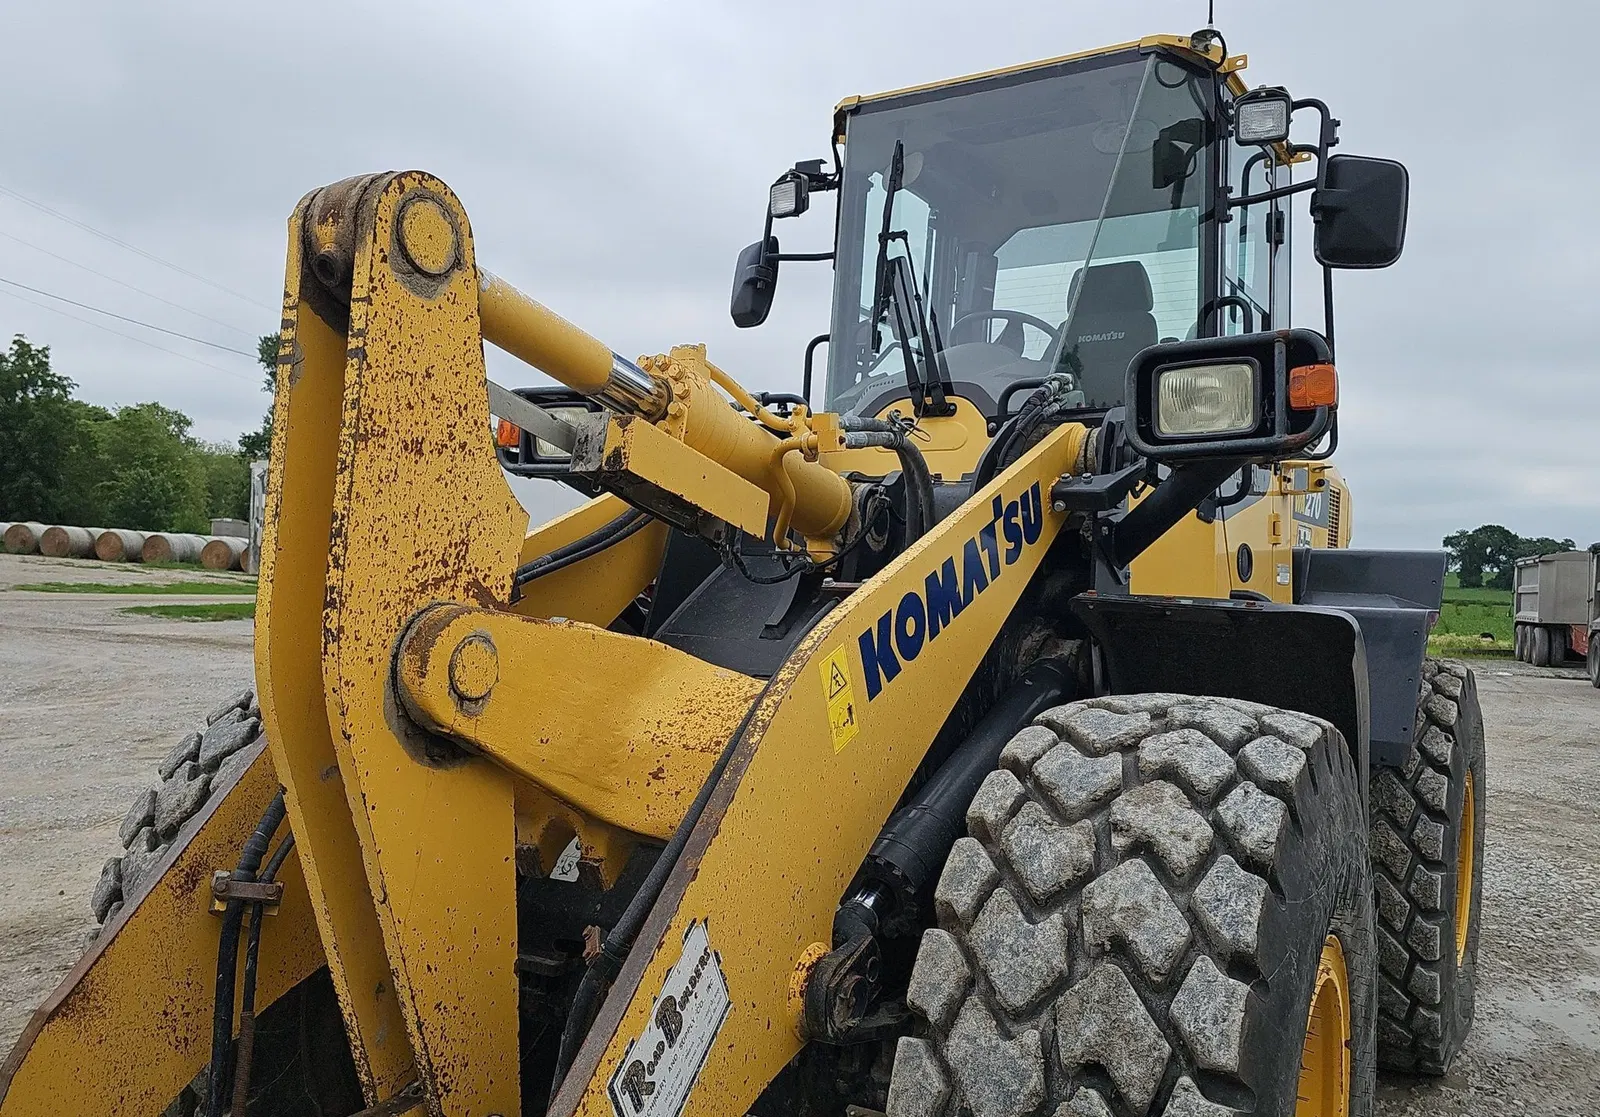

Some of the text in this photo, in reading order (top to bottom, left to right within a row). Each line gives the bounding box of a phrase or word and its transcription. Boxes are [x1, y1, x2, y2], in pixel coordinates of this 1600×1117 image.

[1078, 331, 1125, 343] KOMATSU
[858, 480, 1043, 702] KOMATSU
[668, 1053, 678, 1073] AND
[679, 1017, 695, 1050] SUPPLY
